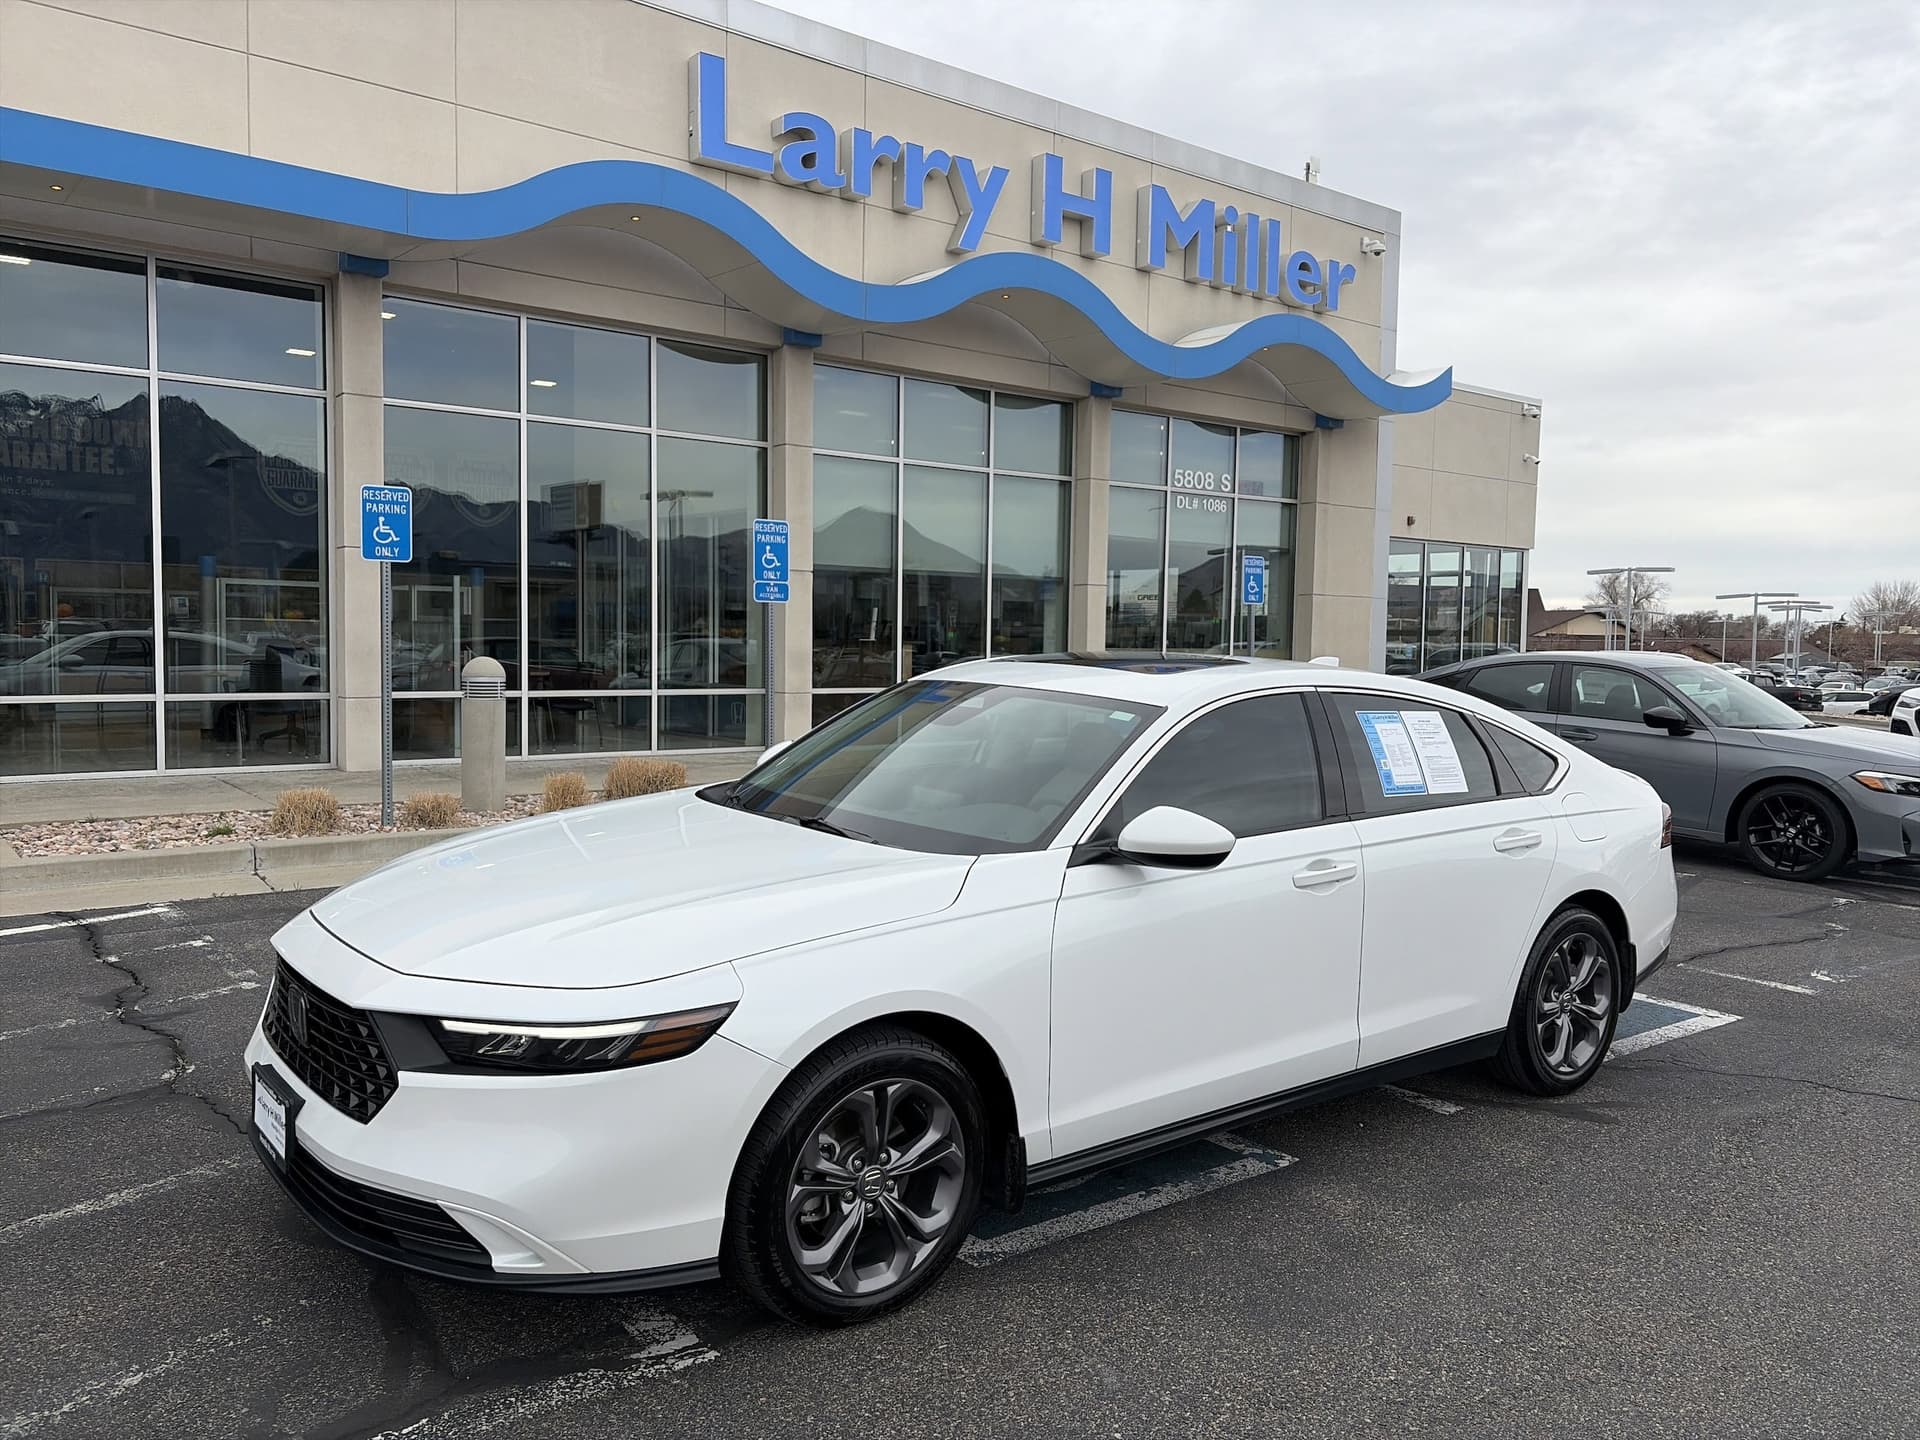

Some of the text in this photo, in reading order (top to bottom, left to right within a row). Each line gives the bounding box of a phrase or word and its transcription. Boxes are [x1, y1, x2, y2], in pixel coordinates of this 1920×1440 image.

[690, 52, 1356, 313] Larry H Miller
[1174, 468, 1231, 492] 5808 S
[363, 489, 409, 502] RESERVED
[366, 502, 407, 515] PARKING
[1176, 495, 1227, 512] DL# 1086
[755, 523, 788, 533] RESERVED
[757, 534, 786, 544] PARKING
[375, 546, 399, 557] ONLY
[763, 570, 780, 579] ONLY
